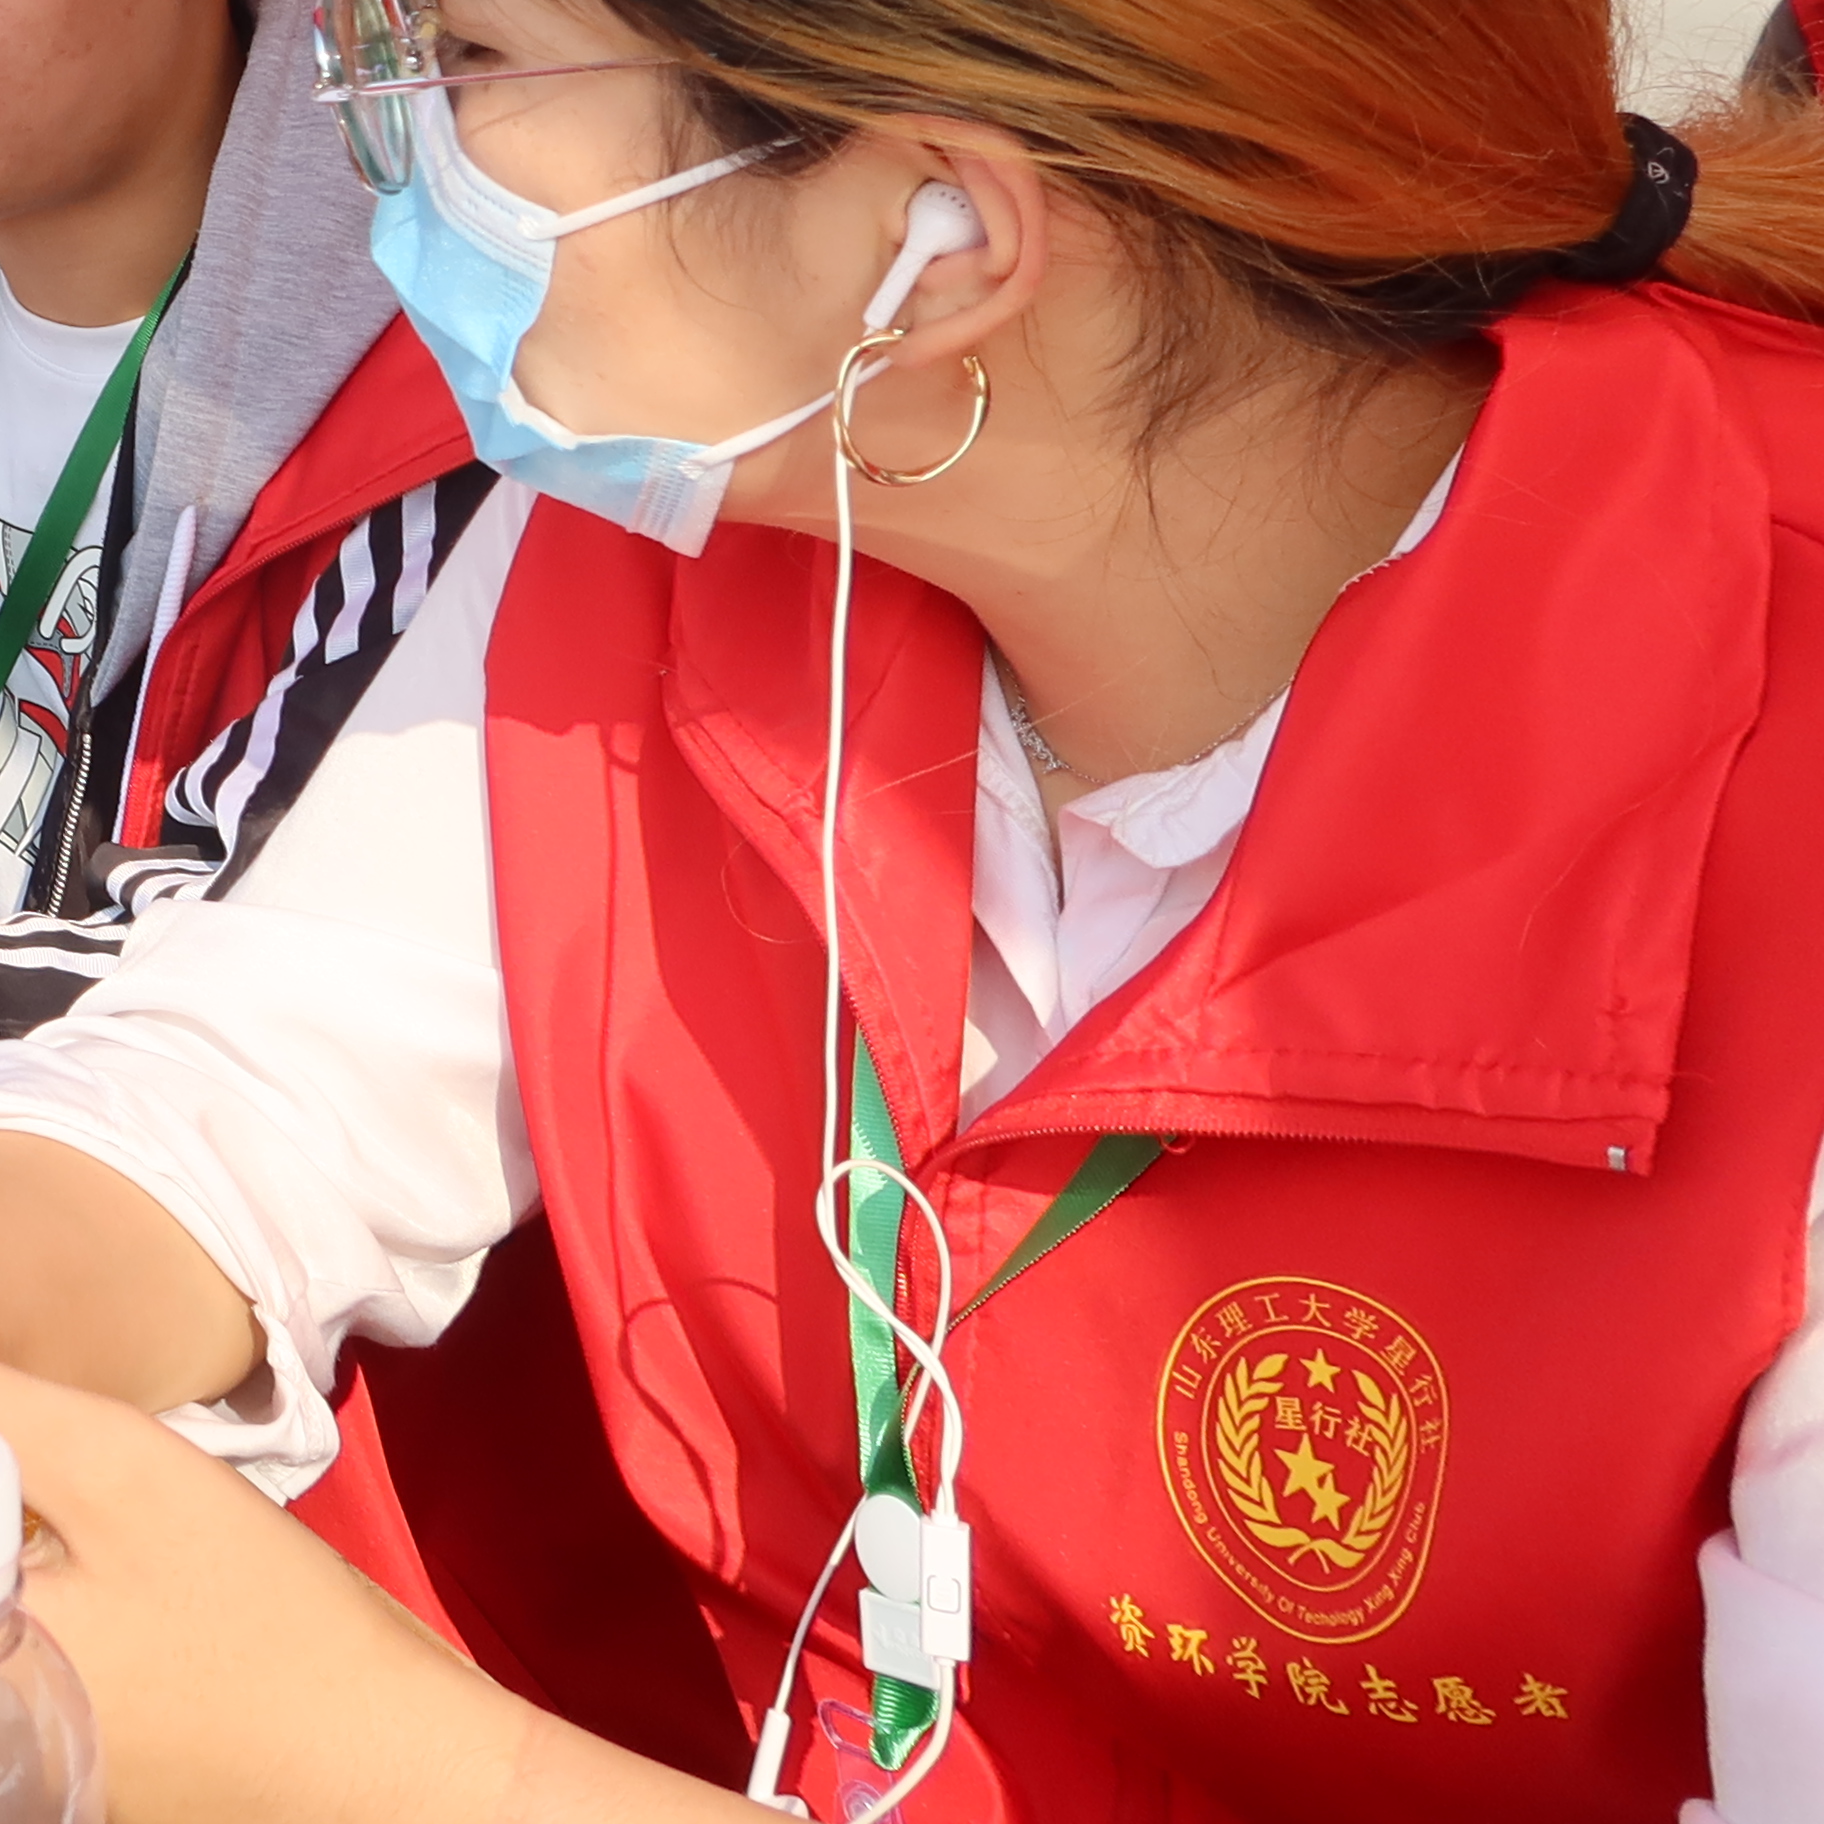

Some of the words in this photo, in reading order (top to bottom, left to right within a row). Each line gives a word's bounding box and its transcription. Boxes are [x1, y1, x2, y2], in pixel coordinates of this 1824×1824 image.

[1172, 1293, 1442, 1454] 山东理工大学星行社
[1274, 1396, 1374, 1457] 星行社
[1173, 1430, 1209, 1525] Shandong
[1206, 1527, 1276, 1604] University
[1363, 1584, 1395, 1613] Xing
[1406, 1501, 1427, 1545] Club
[1108, 1592, 1570, 1725] 资环学院志愿者
